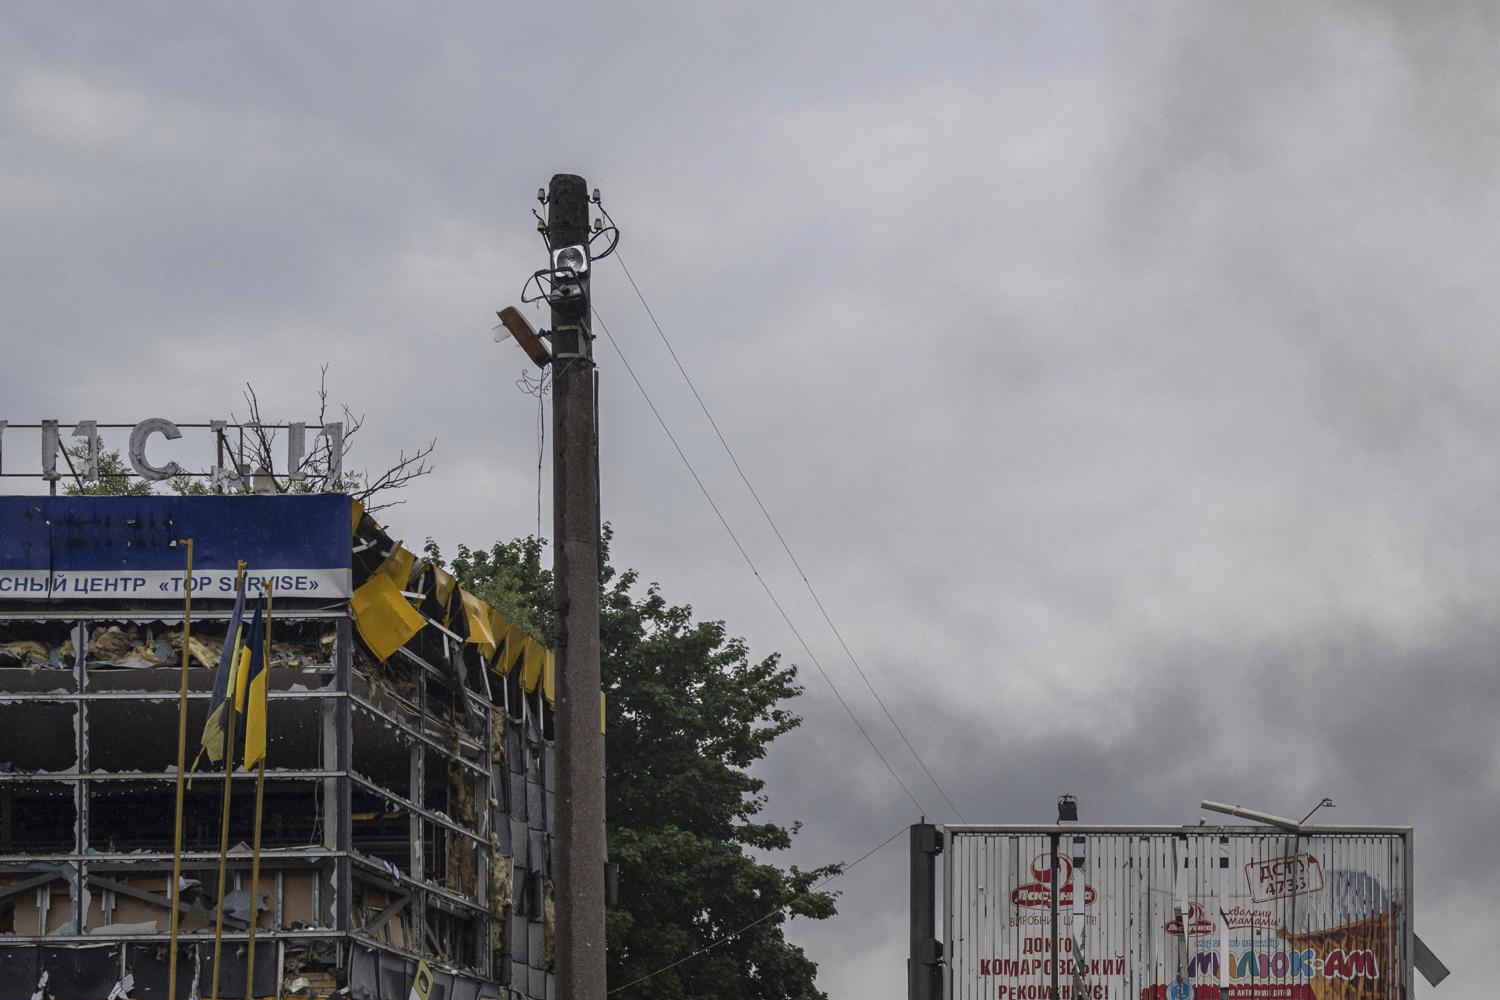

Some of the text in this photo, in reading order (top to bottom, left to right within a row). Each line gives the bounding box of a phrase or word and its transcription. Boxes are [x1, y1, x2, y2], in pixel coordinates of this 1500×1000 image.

[74, 577, 146, 595] ЦЕНТР
[1009, 915, 1053, 927] ВИРОБНИ
[1023, 937, 1073, 954] ДОКТО
